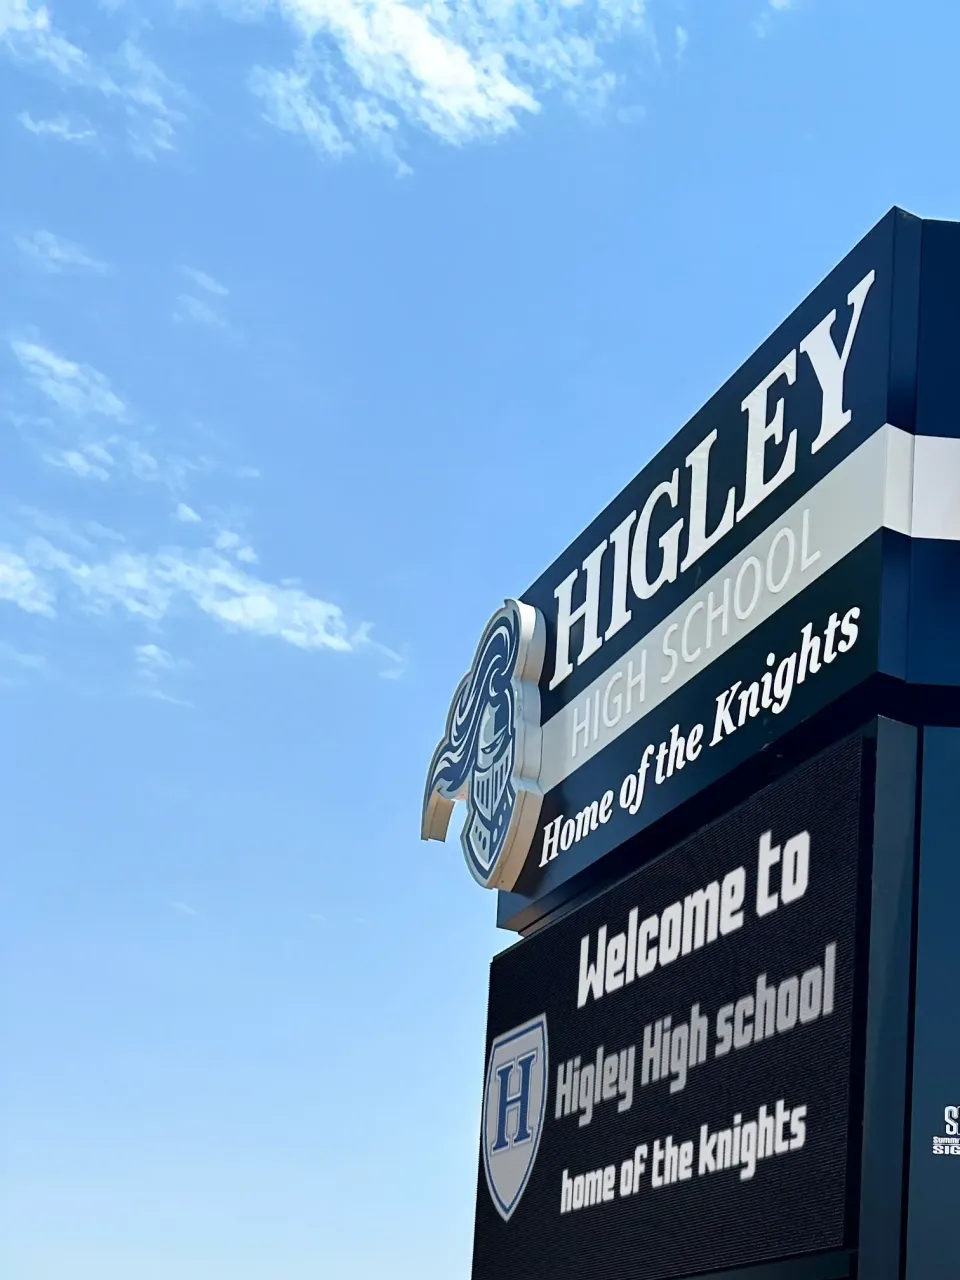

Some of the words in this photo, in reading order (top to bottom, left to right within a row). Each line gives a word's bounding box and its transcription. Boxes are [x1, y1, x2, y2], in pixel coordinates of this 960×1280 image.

[549, 269, 875, 690] HIGLEY
[571, 659, 647, 757] HIGH
[661, 508, 822, 686] SCHOOL
[539, 794, 613, 868] Home
[620, 742, 655, 816] of
[655, 715, 703, 784] the
[709, 605, 861, 749] Knights
[577, 866, 746, 1009] Welcome
[756, 829, 811, 918] to
[491, 1050, 538, 1156] H
[554, 1042, 637, 1128] Higley
[641, 1003, 706, 1094] High
[714, 942, 837, 1058] school
[560, 1168, 615, 1214] home
[619, 1144, 649, 1198] of
[651, 1134, 693, 1187] the
[698, 1098, 808, 1182] knights
